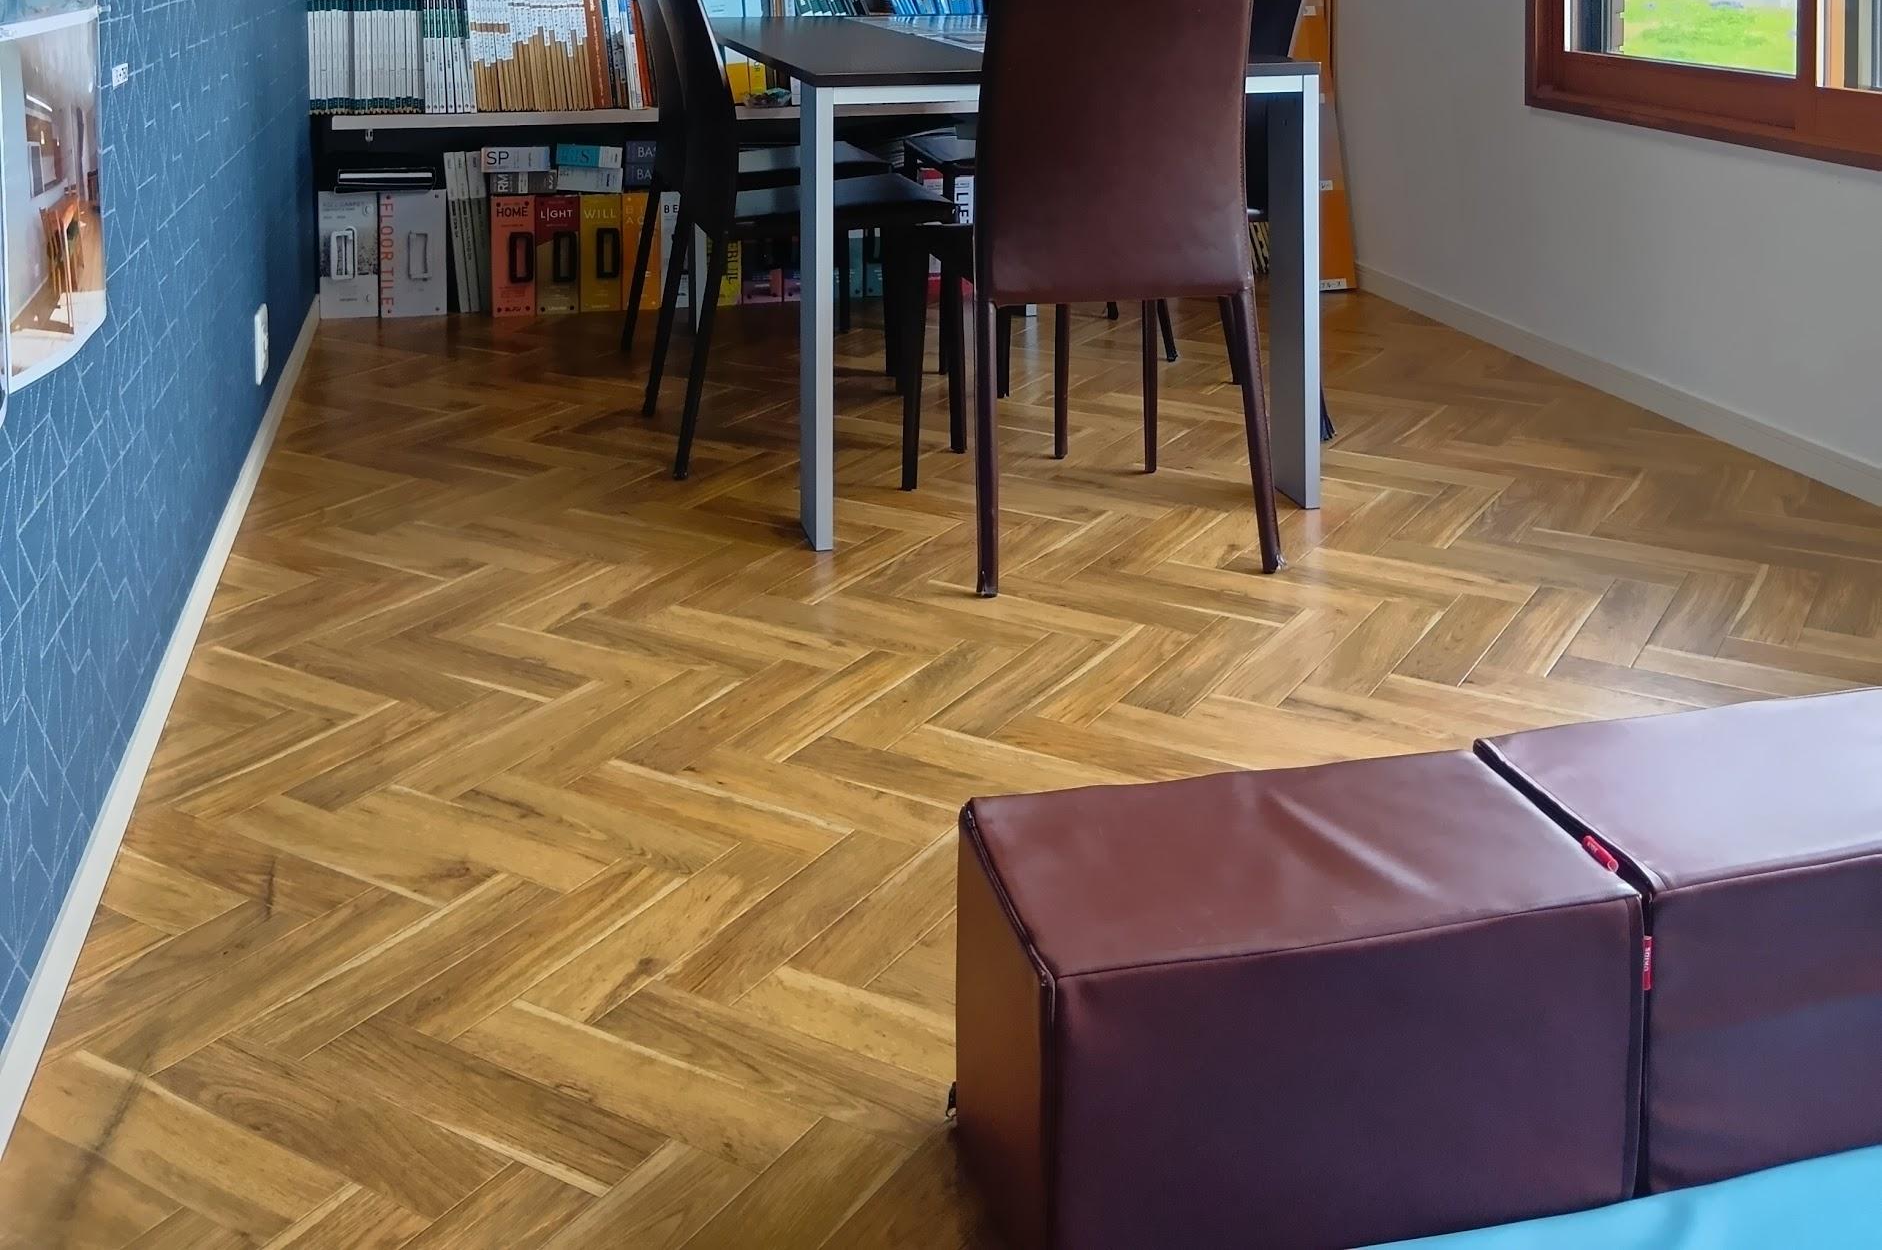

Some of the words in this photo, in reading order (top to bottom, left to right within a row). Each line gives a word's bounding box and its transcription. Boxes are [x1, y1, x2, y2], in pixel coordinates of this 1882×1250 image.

[486, 151, 509, 165] SP
[496, 206, 528, 218] HOME
[540, 207, 573, 221] LIGHT
[584, 209, 617, 220] WILL
[381, 203, 394, 261] FLOOR
[381, 268, 394, 306] TILE
